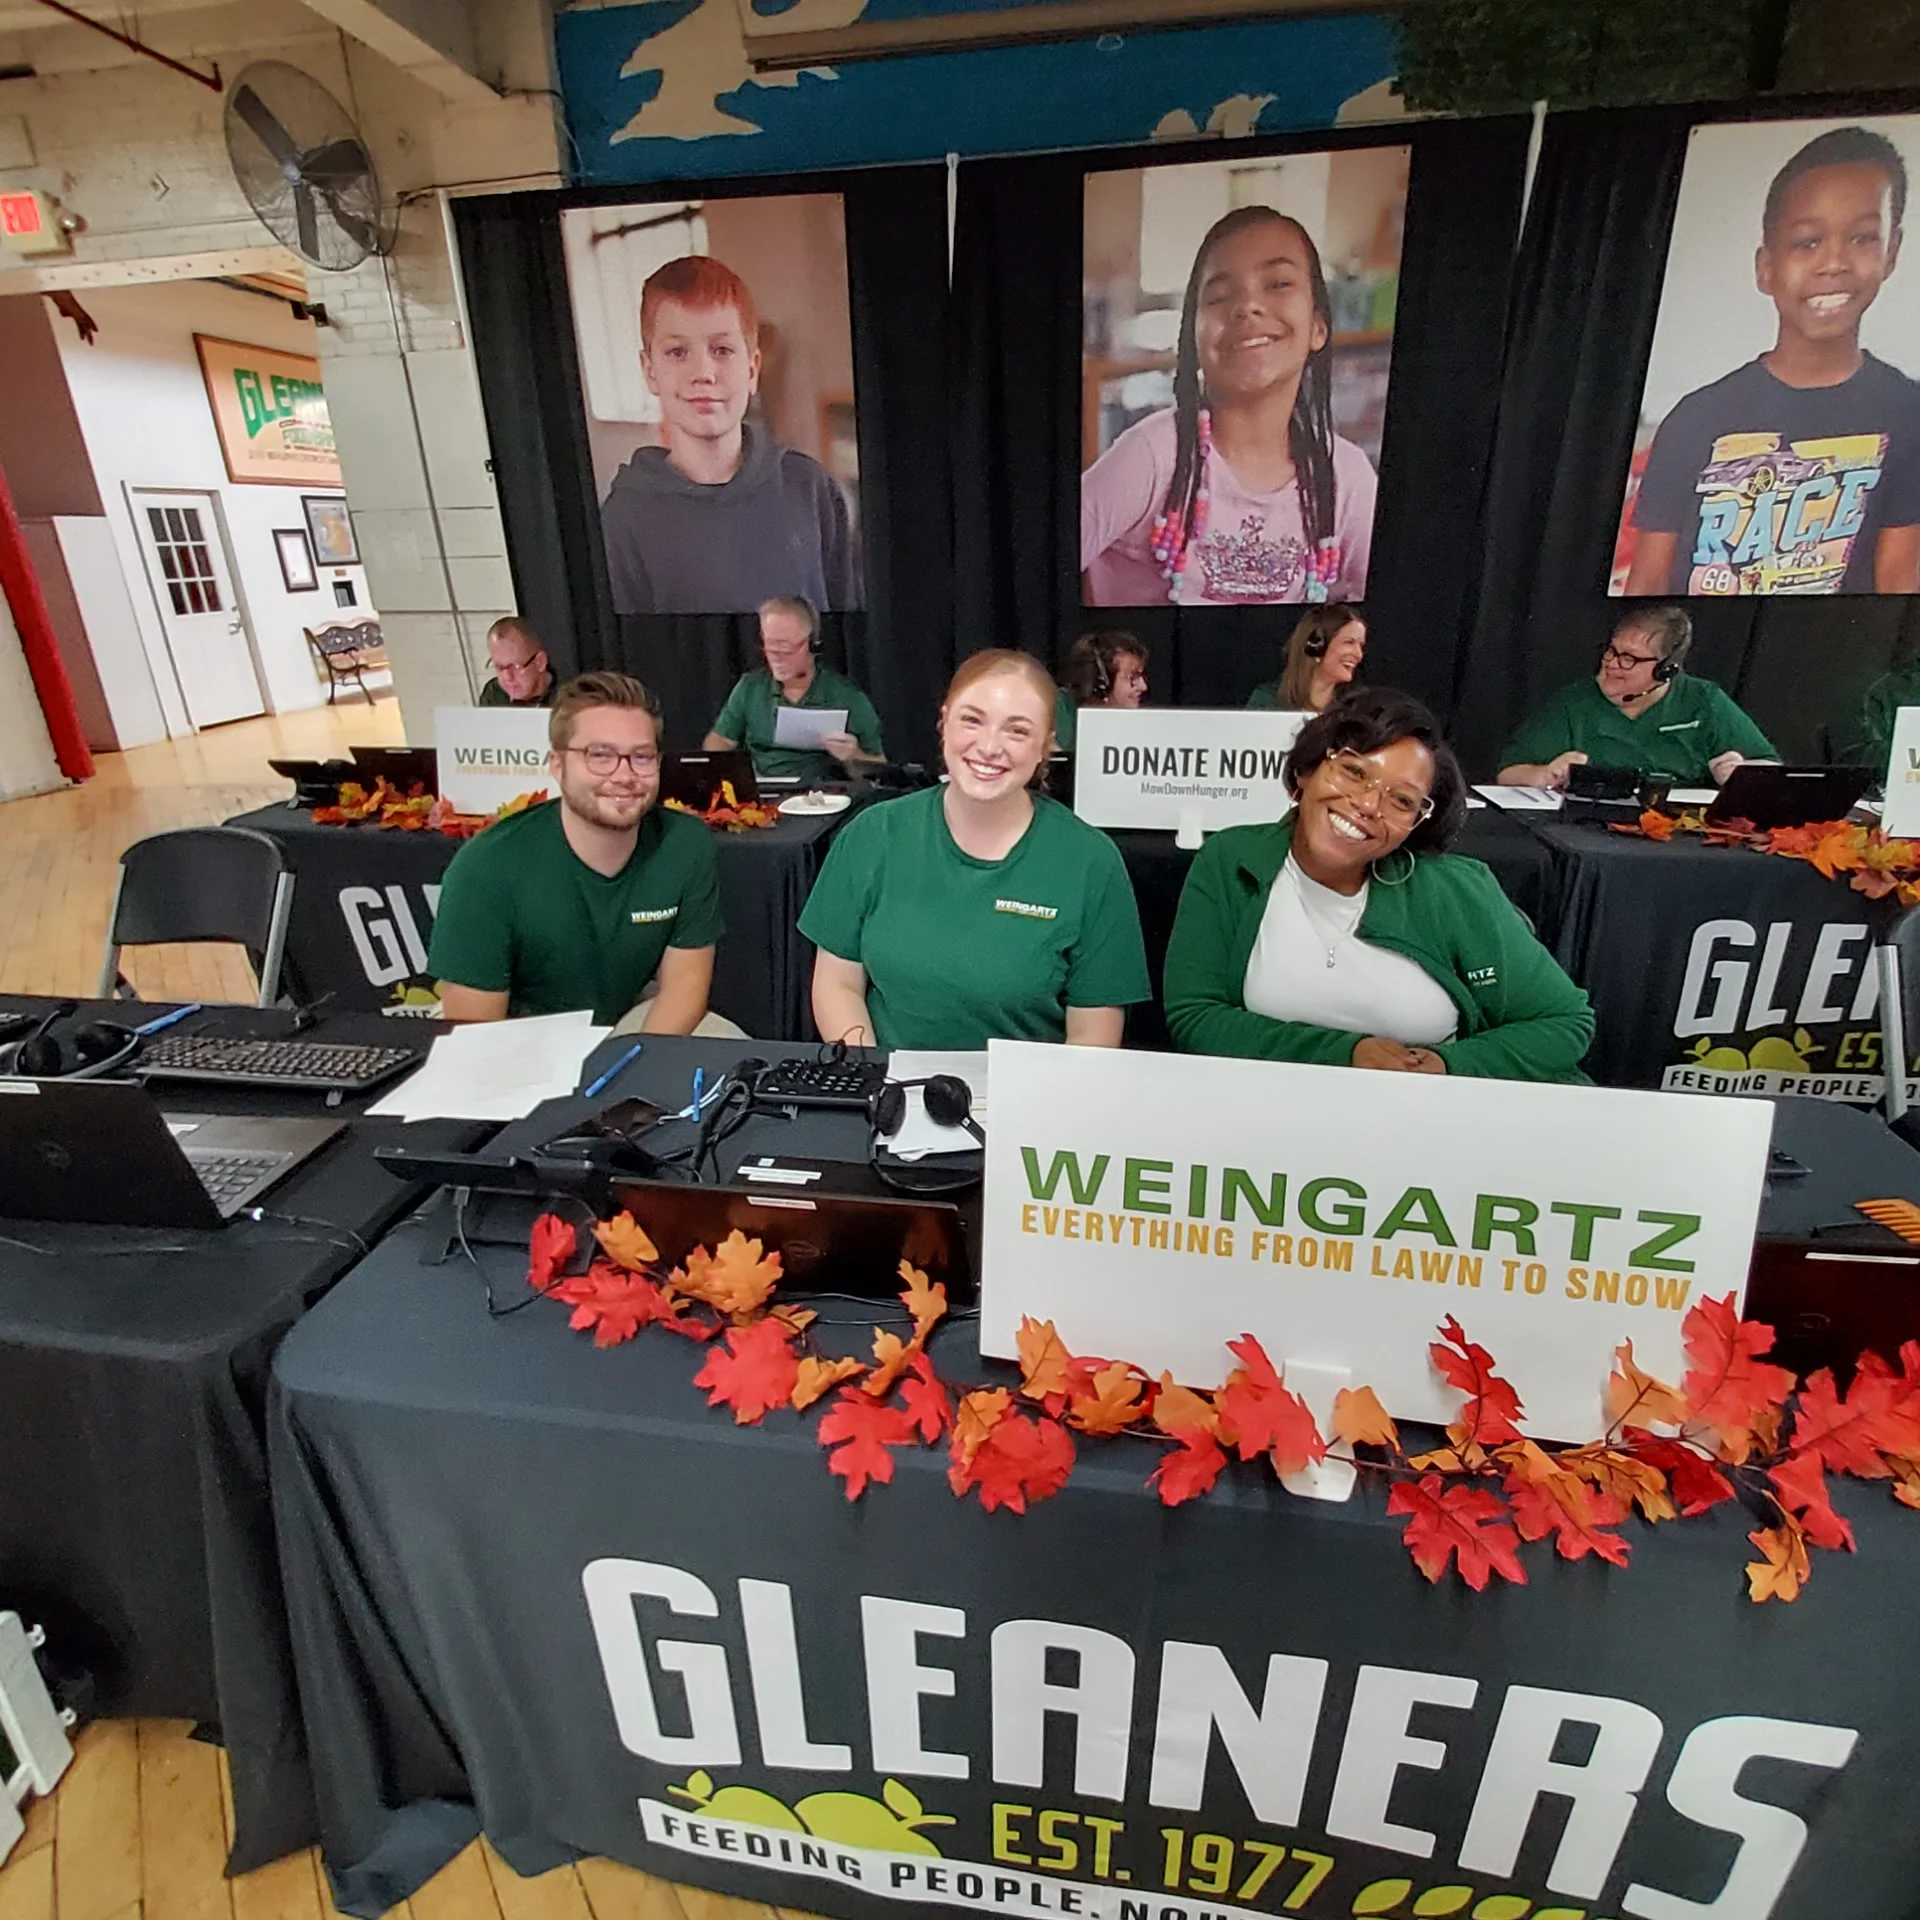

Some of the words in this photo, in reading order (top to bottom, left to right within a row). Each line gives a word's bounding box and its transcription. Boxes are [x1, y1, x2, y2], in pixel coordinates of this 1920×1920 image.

[1692, 469, 1882, 565] RACE
[1102, 745, 1208, 778] DONATE
[1219, 748, 1285, 780] NOW
[1140, 782, 1249, 799] MowDownHunger.org
[996, 899, 1059, 917] WEINGARTZ
[1669, 1070, 1767, 1093] FEEDING
[1779, 1078, 1877, 1097] PEOPLE.
[1020, 1146, 1702, 1273] WEINGARTZ
[1022, 1204, 1234, 1257] EVERYTHING
[1252, 1231, 1354, 1272] FROM
[1371, 1245, 1483, 1288] LAWN
[1502, 1260, 1547, 1295] TO
[1565, 1267, 1691, 1310] SNOW
[582, 1558, 1860, 1920] GLEANERS
[661, 1813, 862, 1880] FEEDING
[890, 1862, 1100, 1919] PEOPLE.
[992, 1803, 1131, 1881] EST.
[1160, 1828, 1335, 1909] 1977
